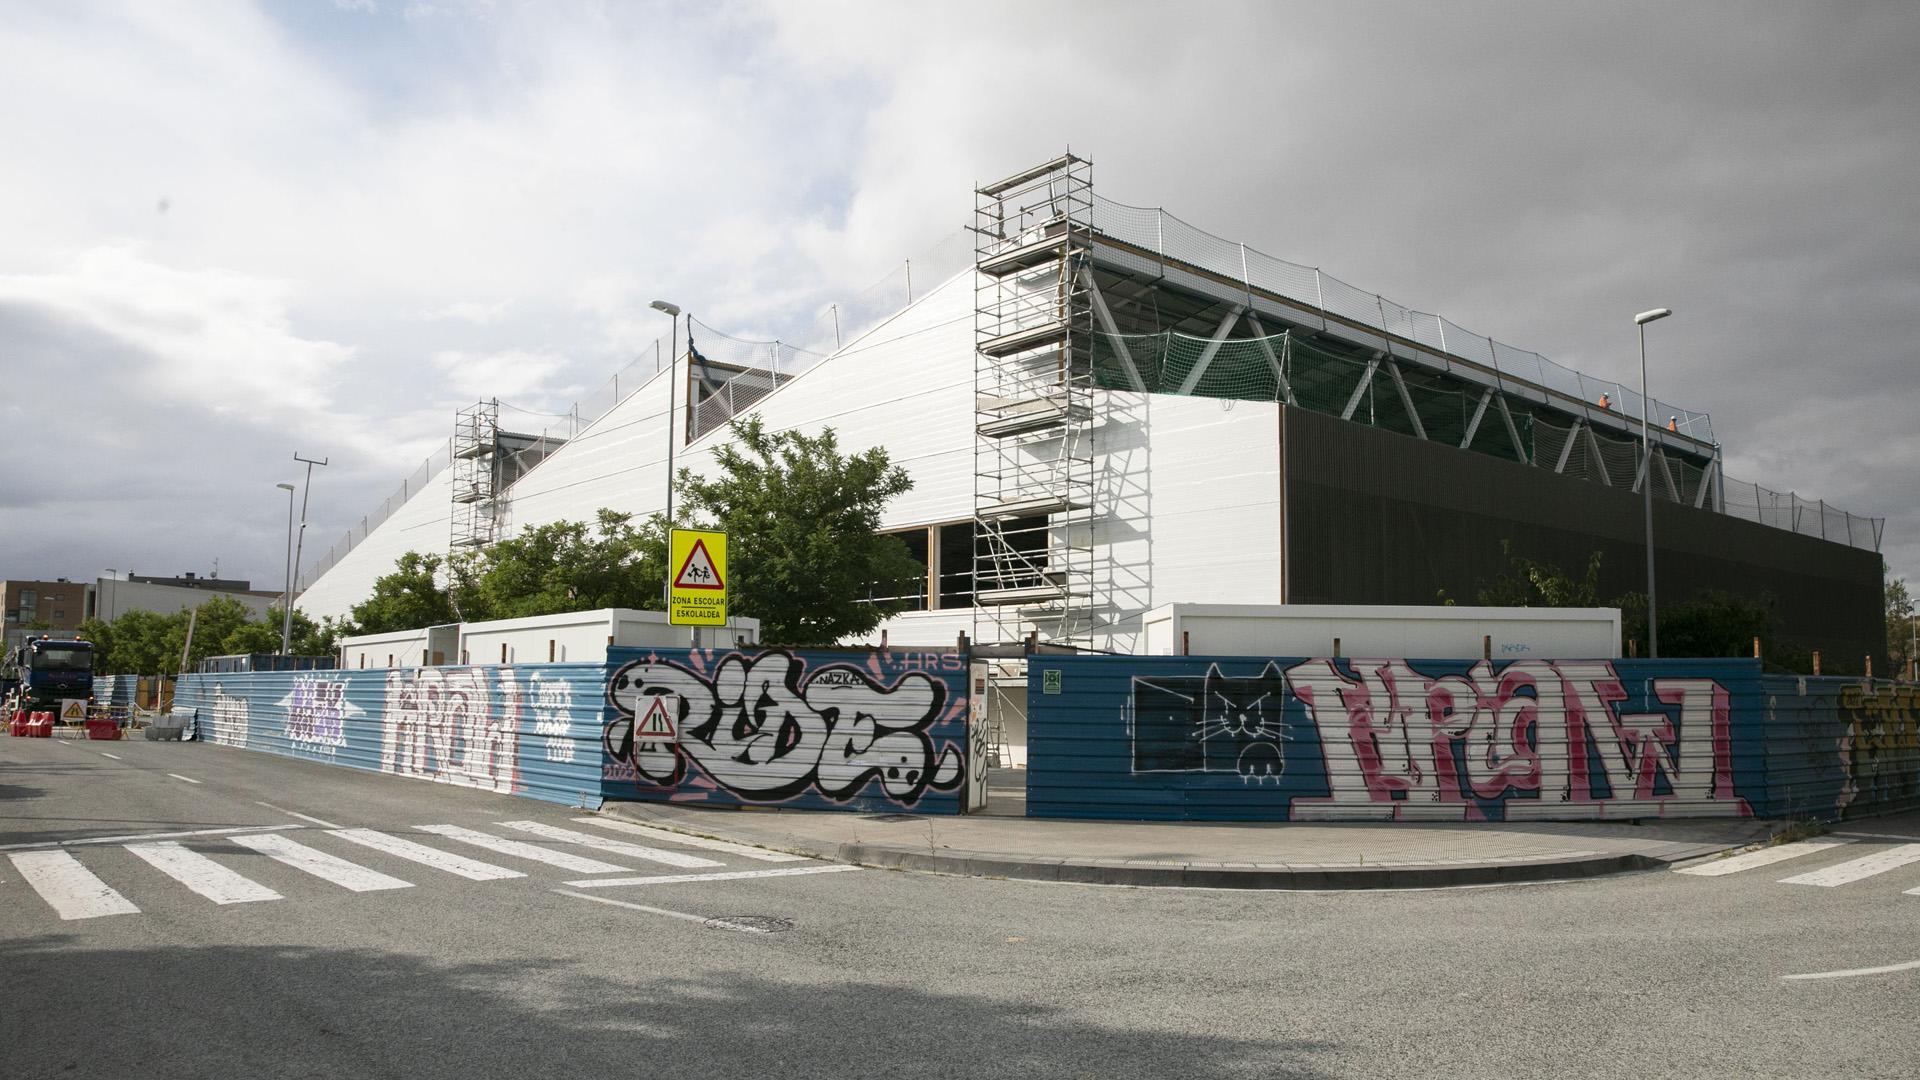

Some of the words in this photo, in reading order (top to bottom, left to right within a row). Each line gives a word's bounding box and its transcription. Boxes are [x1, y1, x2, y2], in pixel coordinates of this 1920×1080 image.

[672, 597, 691, 605] ZONA
[694, 597, 725, 606] ESCOLAR
[676, 610, 720, 619] ESKOLALDEA
